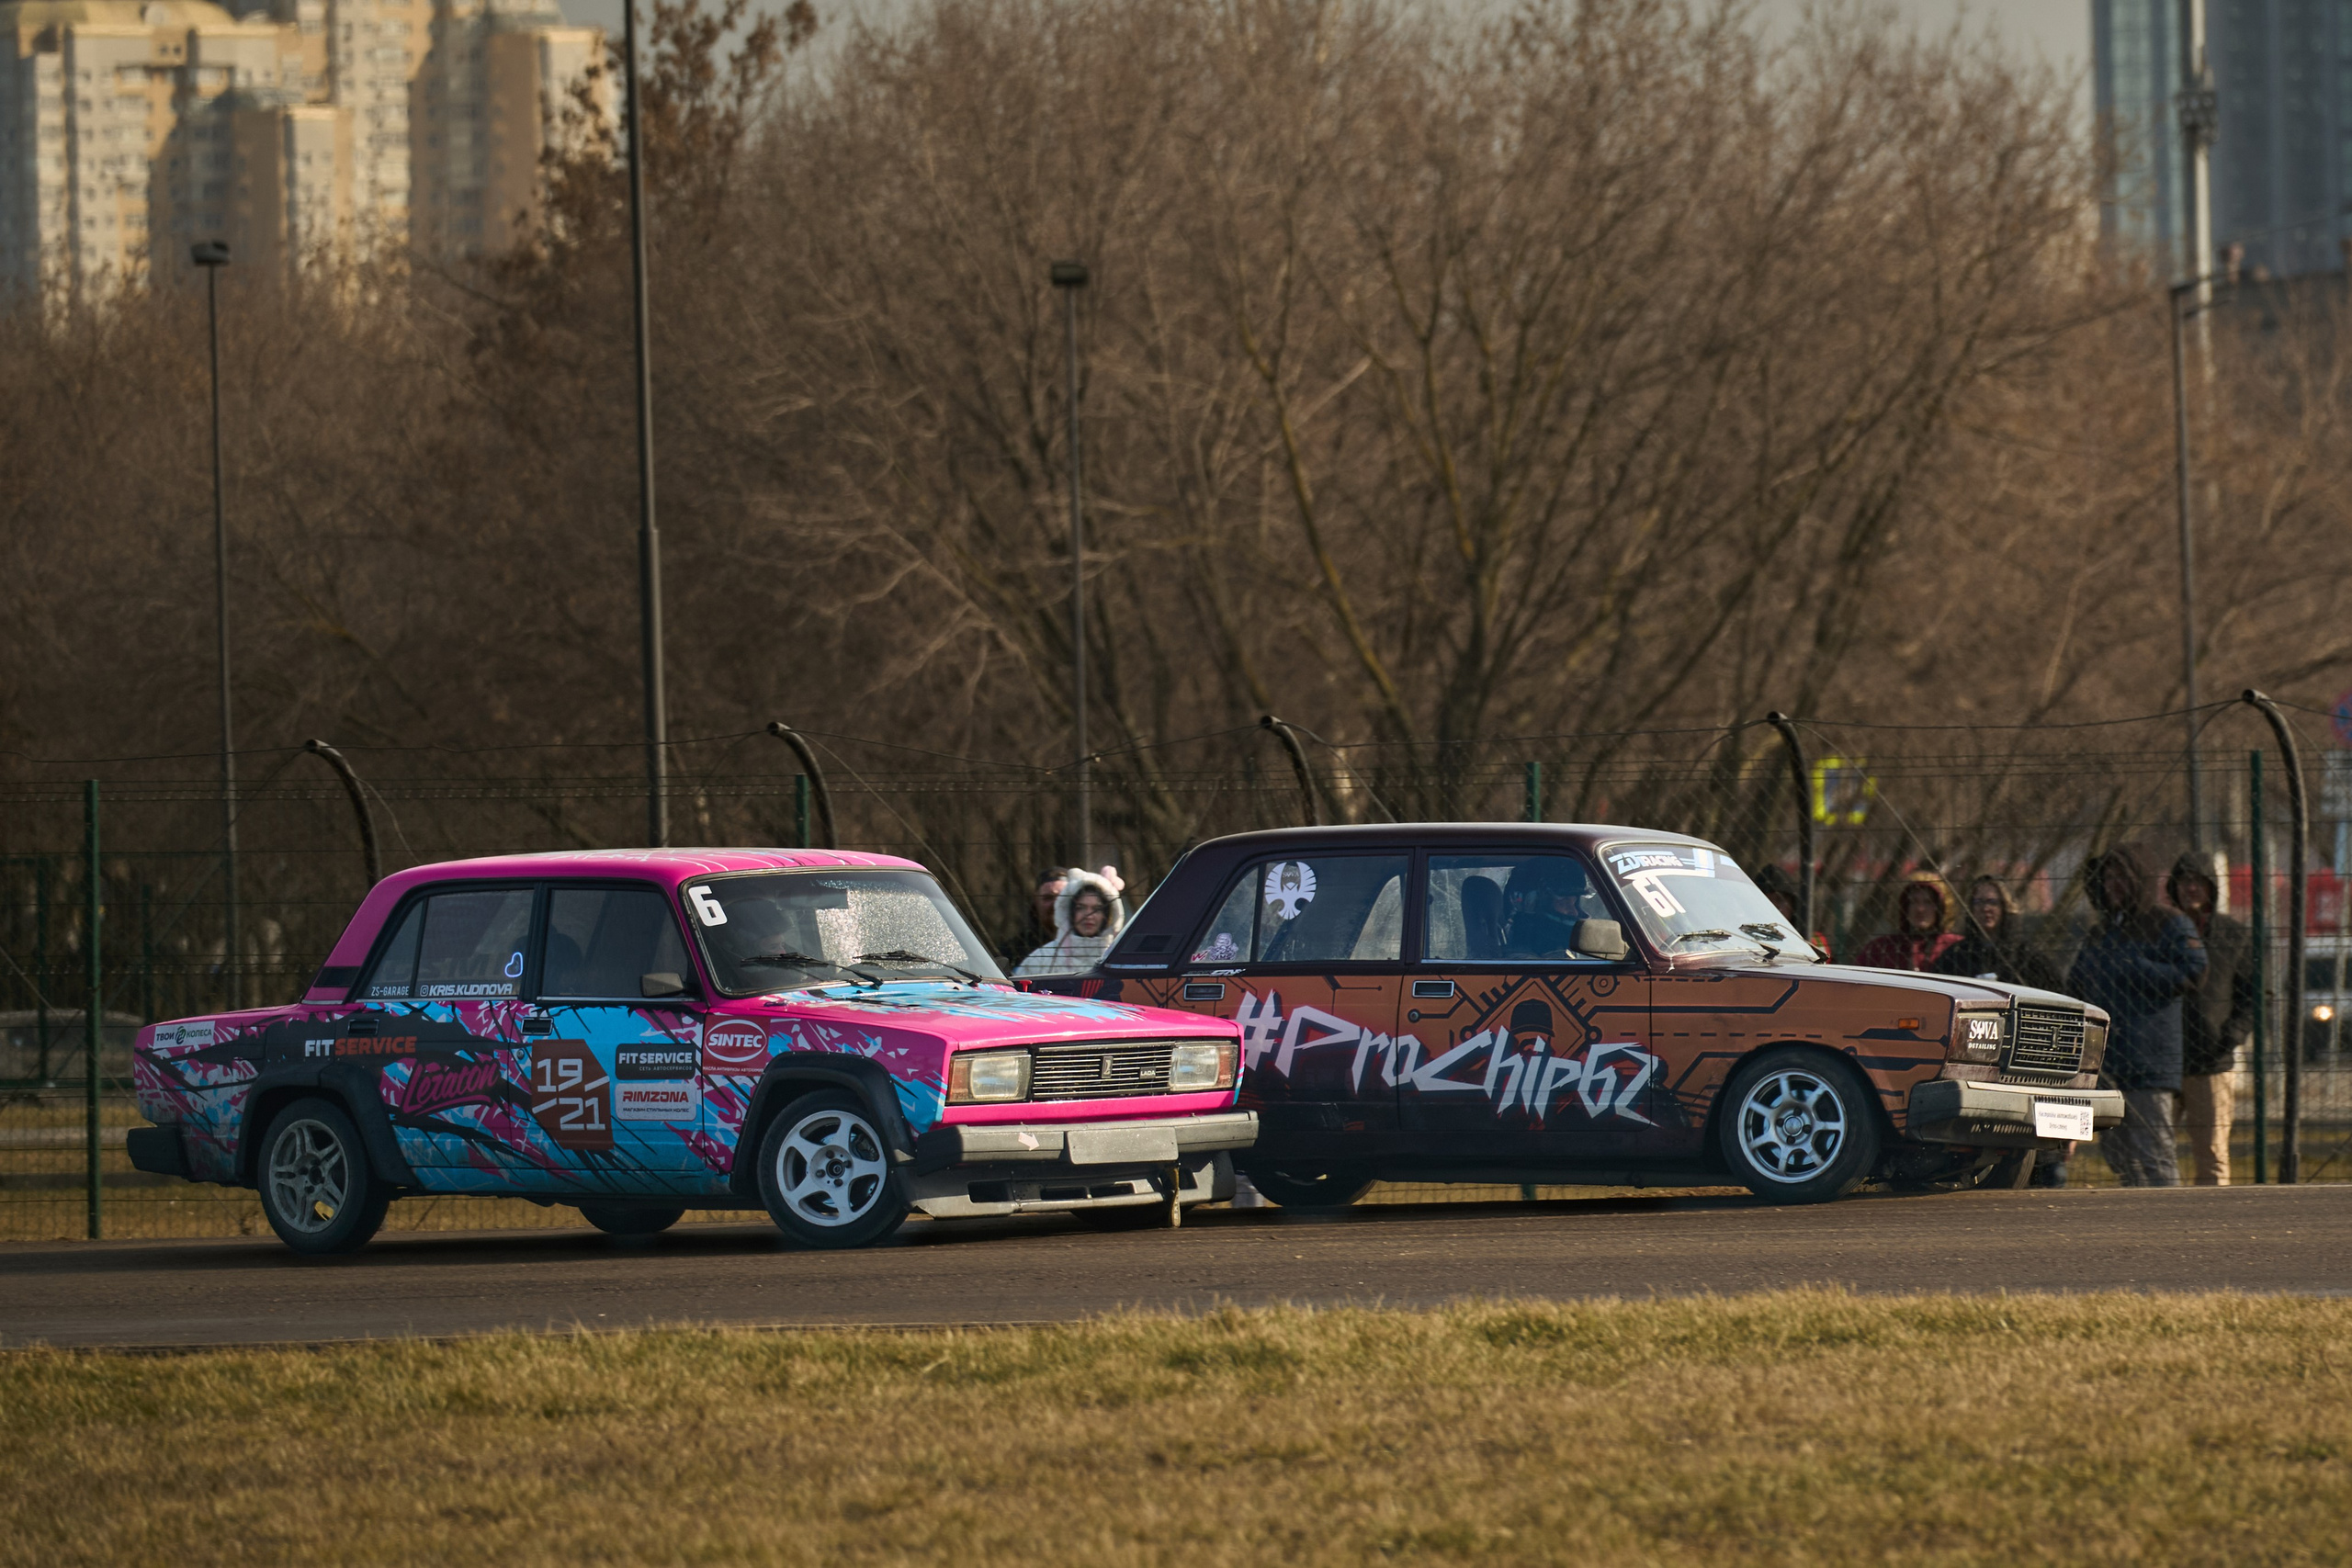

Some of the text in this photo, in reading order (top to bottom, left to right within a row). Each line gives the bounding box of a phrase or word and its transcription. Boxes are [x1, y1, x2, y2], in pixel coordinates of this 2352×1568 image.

[1633, 874, 1686, 918] 61
[688, 886, 728, 927] 6
[371, 986, 410, 997] ZS-GARAGE
[187, 1029, 212, 1038] КОЛЕСА
[708, 1033, 763, 1048] SINTEC
[622, 1091, 689, 1102] RIMZONA
